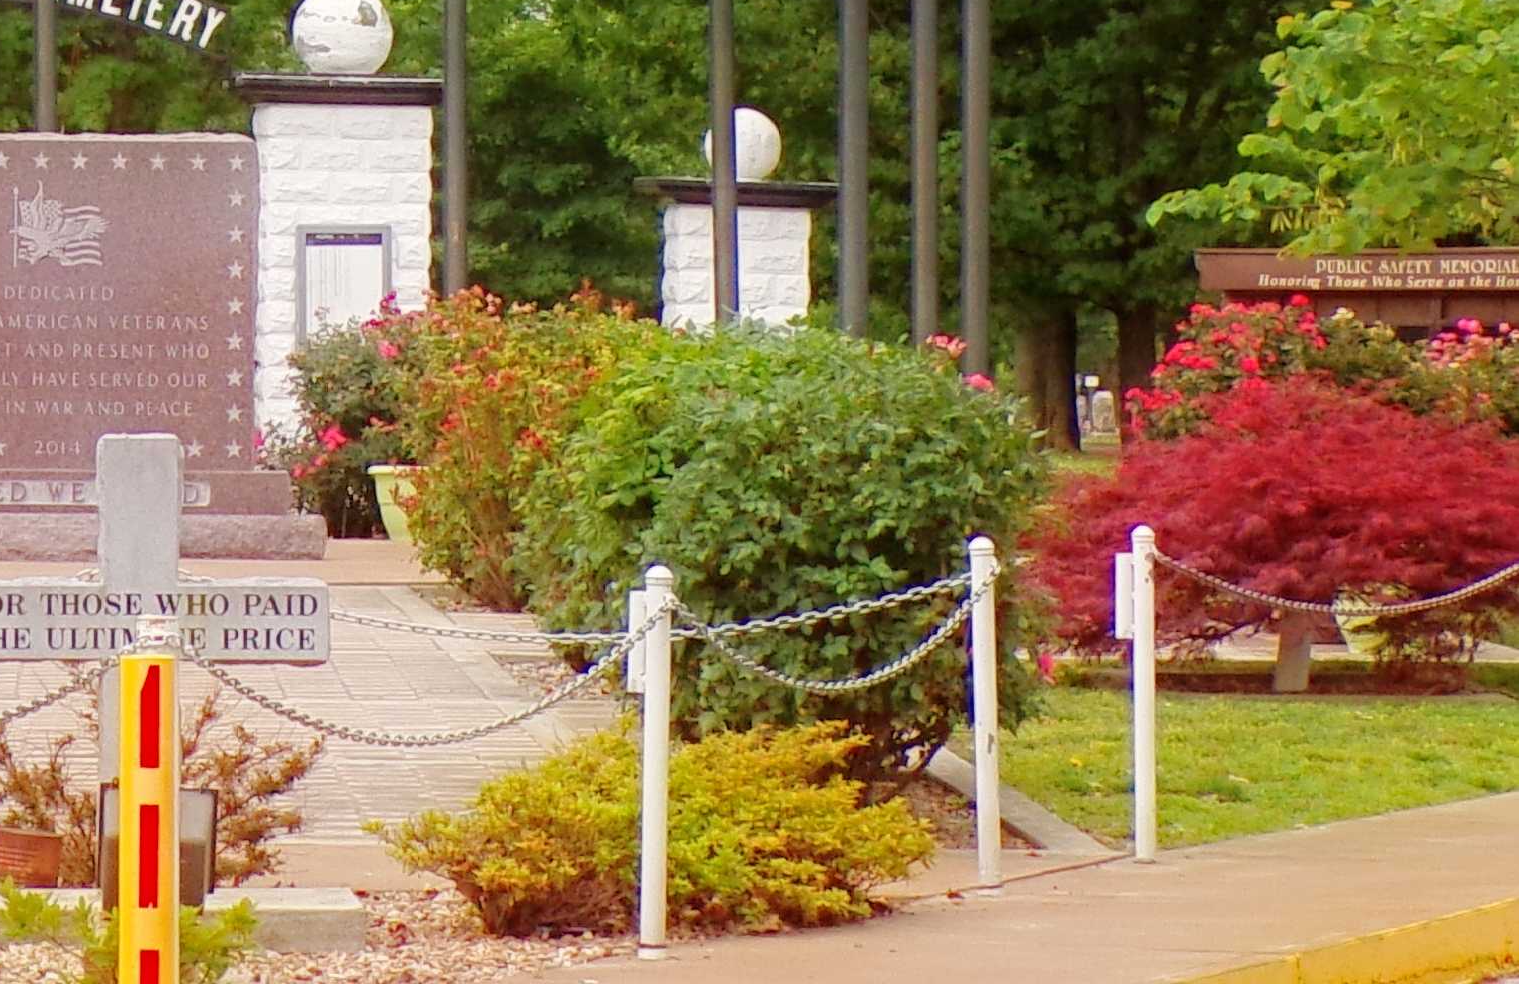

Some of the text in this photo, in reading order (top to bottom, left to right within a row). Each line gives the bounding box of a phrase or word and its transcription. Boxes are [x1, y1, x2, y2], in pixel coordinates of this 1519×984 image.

[1315, 259, 1519, 274] PUBLIC SAFETY MEMORIAL
[1258, 274, 1320, 290] Honoring
[1327, 275, 1368, 288] Those
[1372, 275, 1402, 288] Who
[1406, 276, 1443, 288] Serve
[1448, 278, 1466, 288] on
[1469, 276, 1491, 288] the
[4, 285, 115, 301] DEDICATED
[110, 315, 209, 331] VETERANS
[25, 343, 64, 359] AND
[73, 344, 155, 359] PRESENT
[166, 344, 210, 360] WHO
[33, 372, 80, 388] HAVE
[89, 373, 159, 388] SERVED
[168, 373, 208, 389] OUR
[6, 400, 25, 415] IN
[35, 401, 73, 416] WAR
[84, 401, 124, 416] AND
[136, 401, 194, 417] PEACE
[34, 439, 81, 456] 2014
[47, 482, 85, 503] WE
[40, 592, 142, 617] THOSE
[156, 592, 230, 617] WHO
[244, 593, 318, 618] PAID
[222, 627, 316, 652] PRICE
